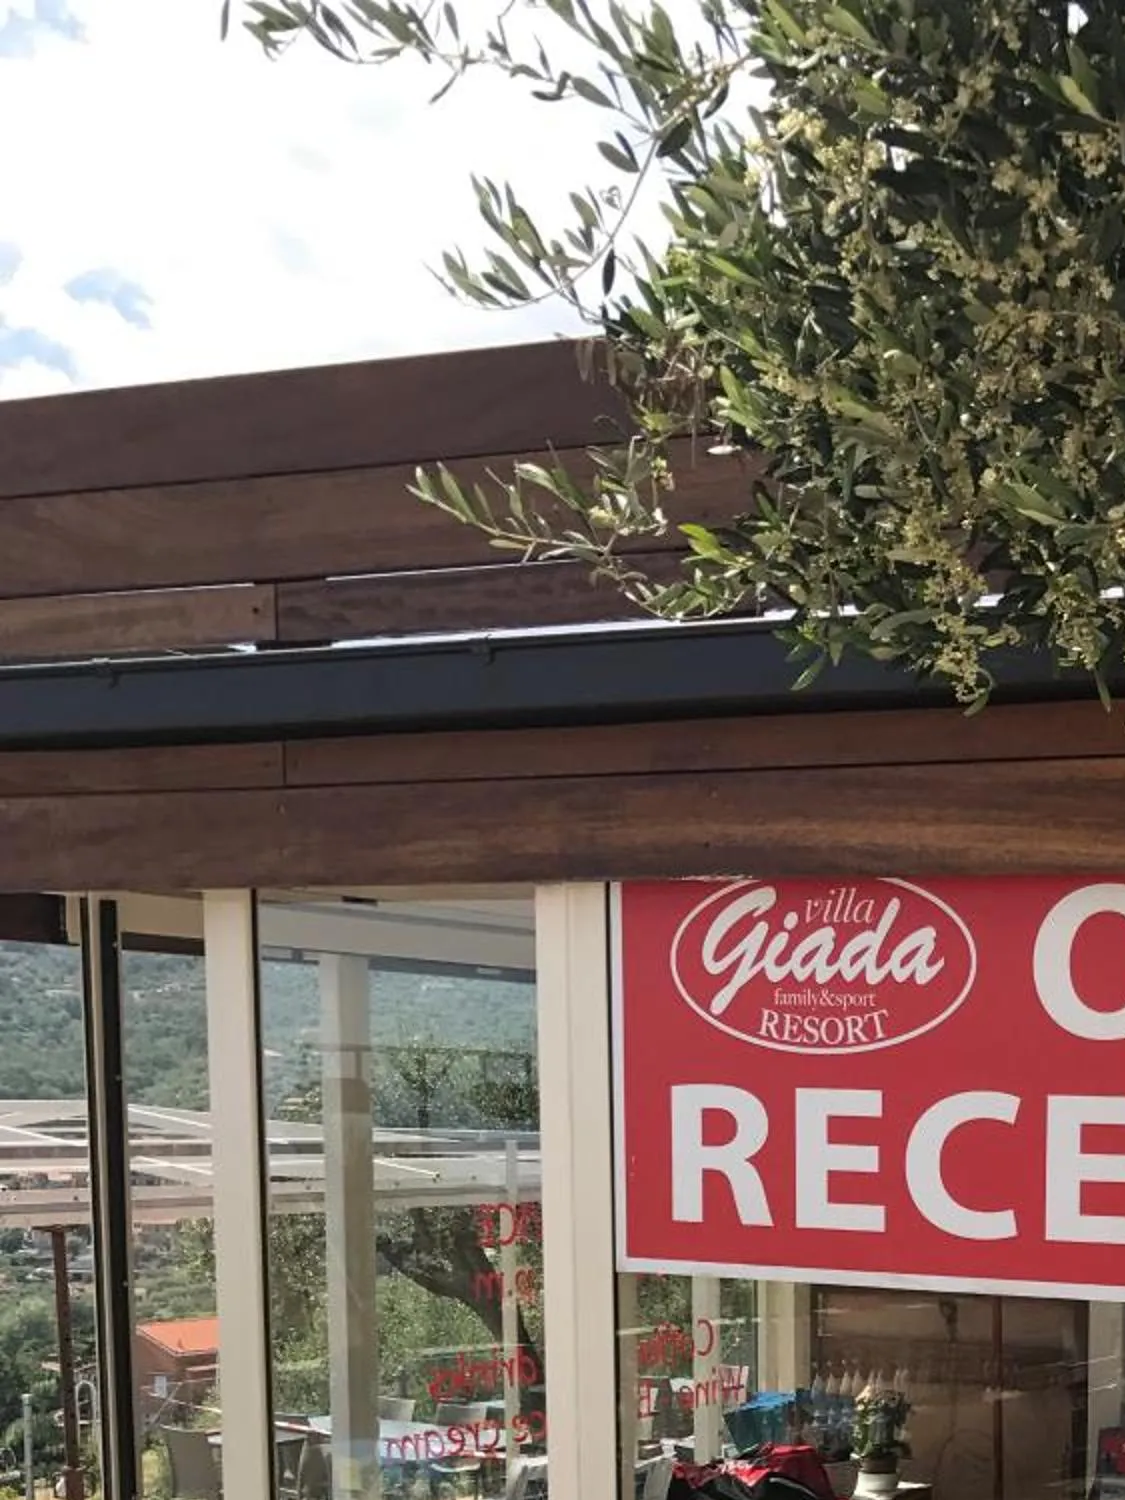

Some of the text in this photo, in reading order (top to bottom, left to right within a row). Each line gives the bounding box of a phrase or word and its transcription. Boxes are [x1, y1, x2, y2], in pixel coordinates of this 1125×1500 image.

[804, 887, 875, 924] villa
[702, 886, 945, 1016] Giada
[774, 988, 877, 1011] family&sport
[758, 1008, 889, 1045] RESORT
